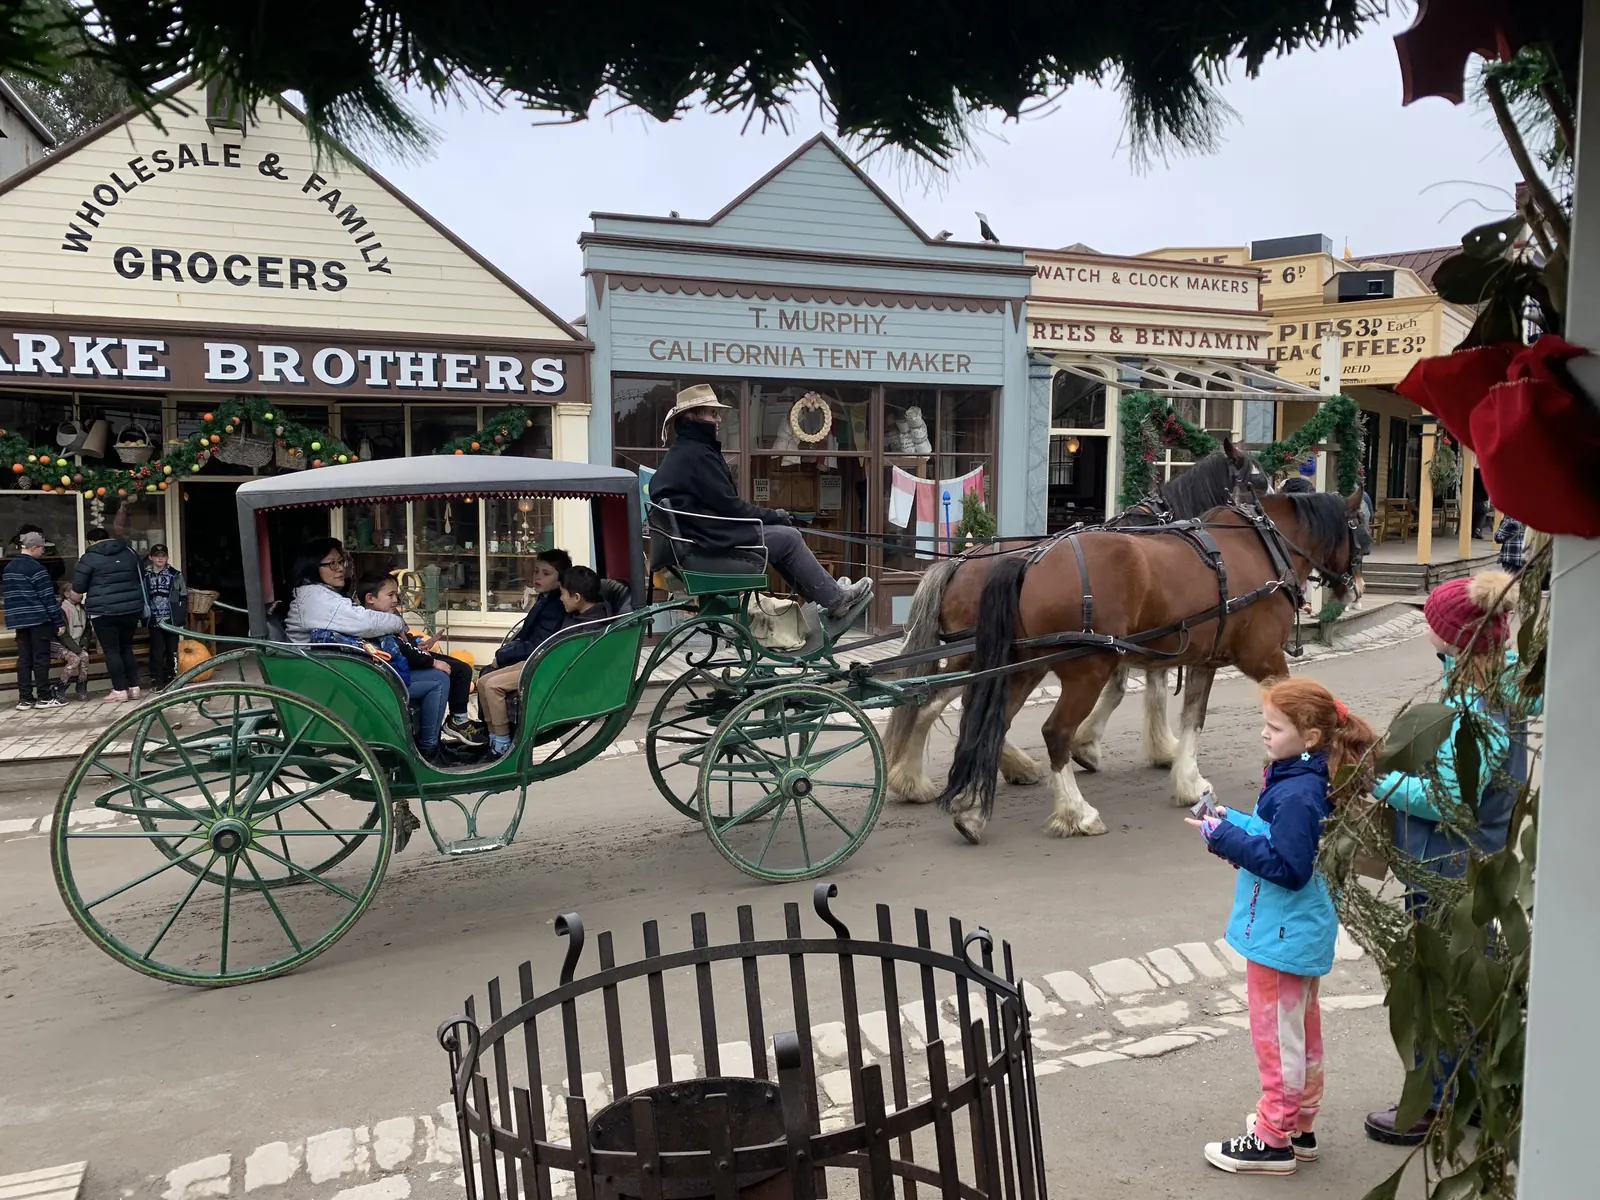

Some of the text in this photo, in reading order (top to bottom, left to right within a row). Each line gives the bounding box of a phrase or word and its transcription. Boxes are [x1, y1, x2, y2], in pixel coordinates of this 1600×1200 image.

[62, 143, 392, 275] WHOLESALE & FAMILY
[113, 246, 348, 292] GROCERS
[1036, 265, 1249, 294] WATCH & CLOCK MAKERS
[748, 307, 887, 335] T. MURPHY.
[1280, 319, 1352, 341] PIES
[1387, 318, 1417, 332] Each
[1032, 322, 1260, 352] REES & BENJAMIN
[1311, 338, 1400, 360] CFFEE
[203, 342, 566, 395] BROTHERS
[649, 339, 972, 373] CALIFORNIA TENT MAKER
[1343, 364, 1371, 374] REID
